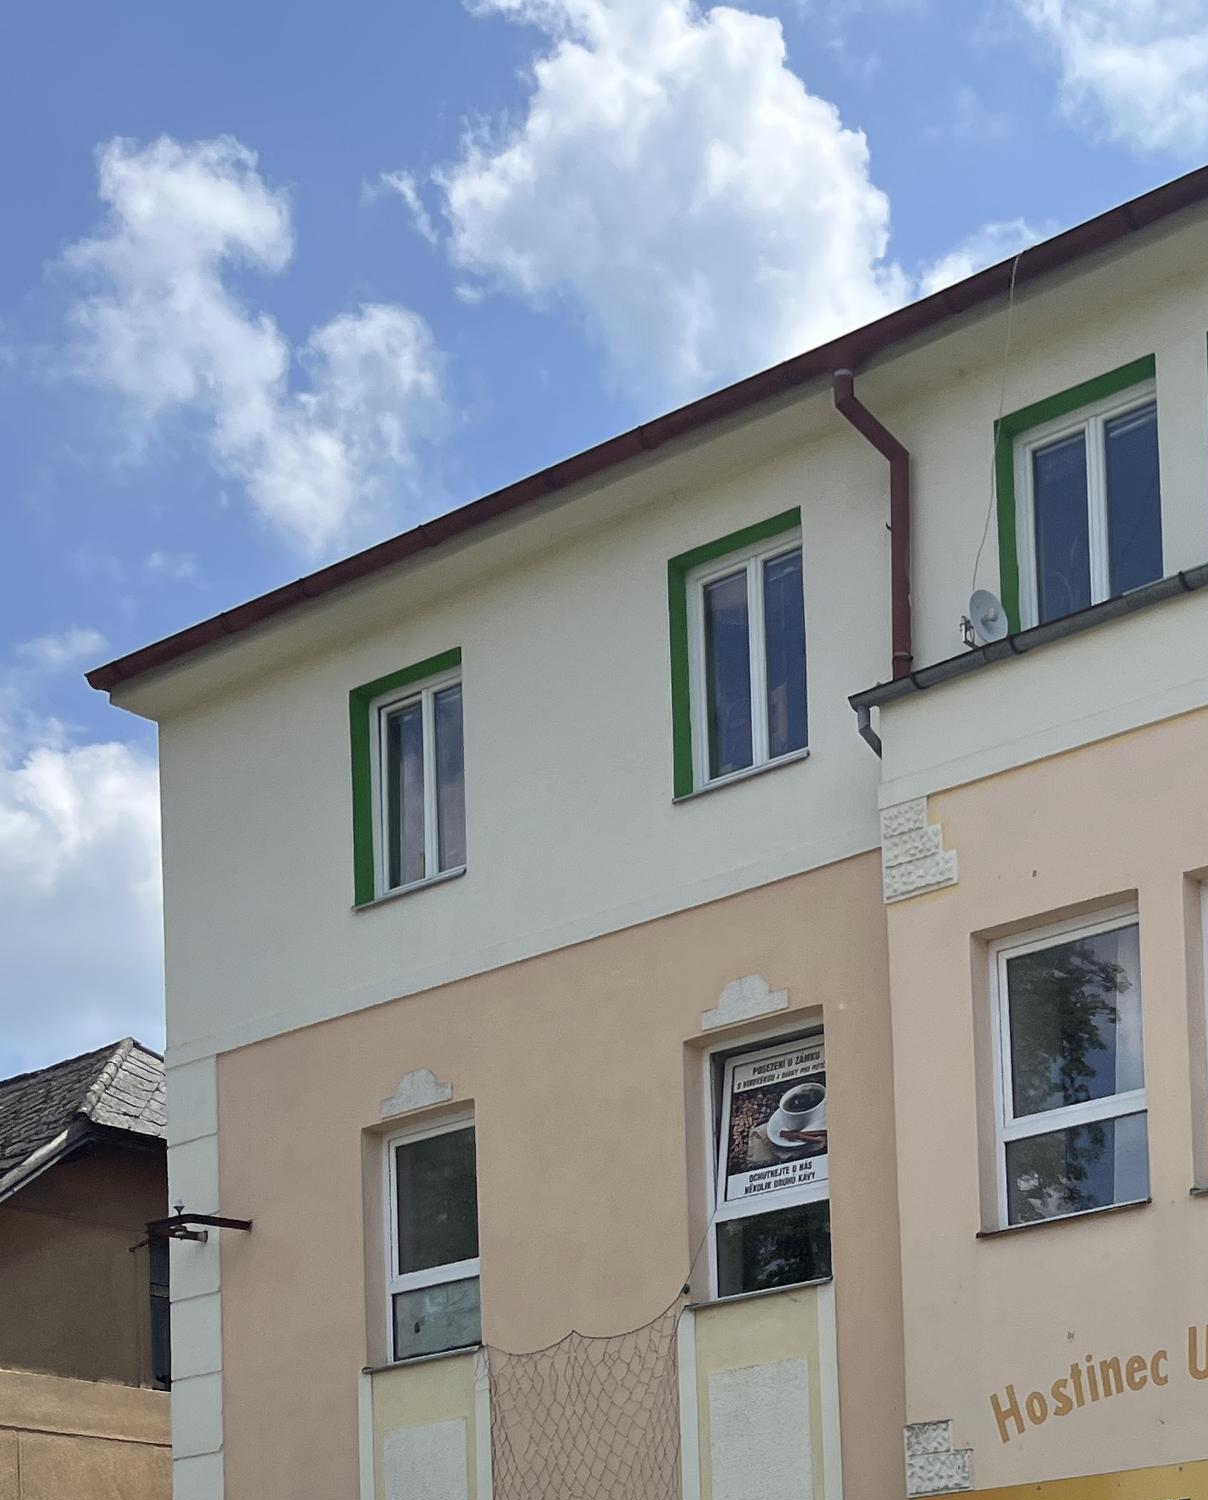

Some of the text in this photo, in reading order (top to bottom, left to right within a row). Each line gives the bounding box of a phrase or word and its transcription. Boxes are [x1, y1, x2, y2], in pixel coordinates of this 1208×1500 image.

[795, 1051, 820, 1066] ZÁMKU
[744, 1171, 816, 1194] NĚKOLIK DRUHŮ KÁVY
[749, 1166, 790, 1183] OCHUTNEJTE
[799, 1160, 812, 1172] NÁS
[989, 1349, 1169, 1444] Hostinec
